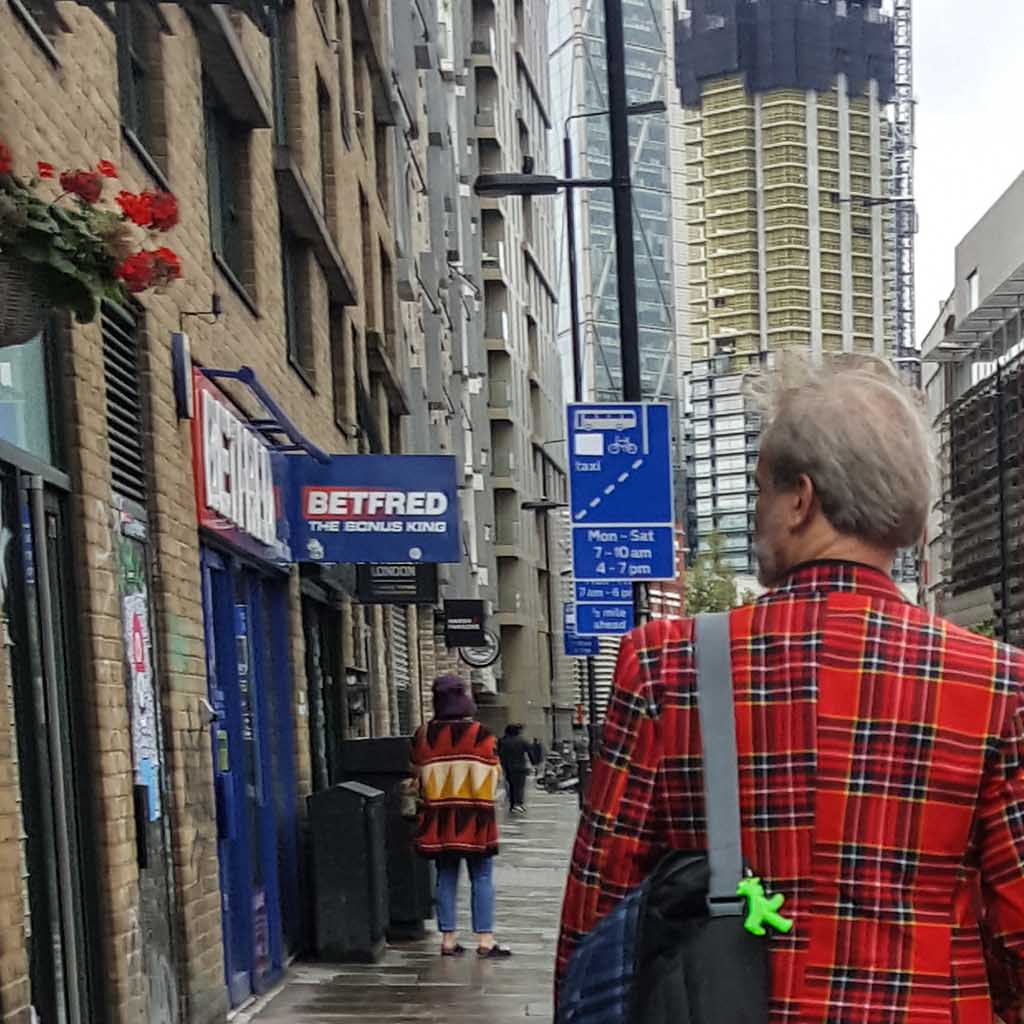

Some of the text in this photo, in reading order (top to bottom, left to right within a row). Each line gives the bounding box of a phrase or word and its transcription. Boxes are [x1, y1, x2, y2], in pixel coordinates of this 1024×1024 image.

[576, 460, 601, 472] taxi
[307, 491, 448, 516] BETFRED
[308, 520, 447, 533] THE BONUS KING
[587, 529, 618, 542] Mon
[629, 529, 655, 542] Sat
[593, 546, 603, 558] 7
[613, 546, 629, 558] 10
[630, 548, 652, 558] am
[371, 566, 416, 577] LONDON
[595, 562, 606, 574] 4
[617, 562, 627, 574] 7
[628, 564, 652, 576] pm
